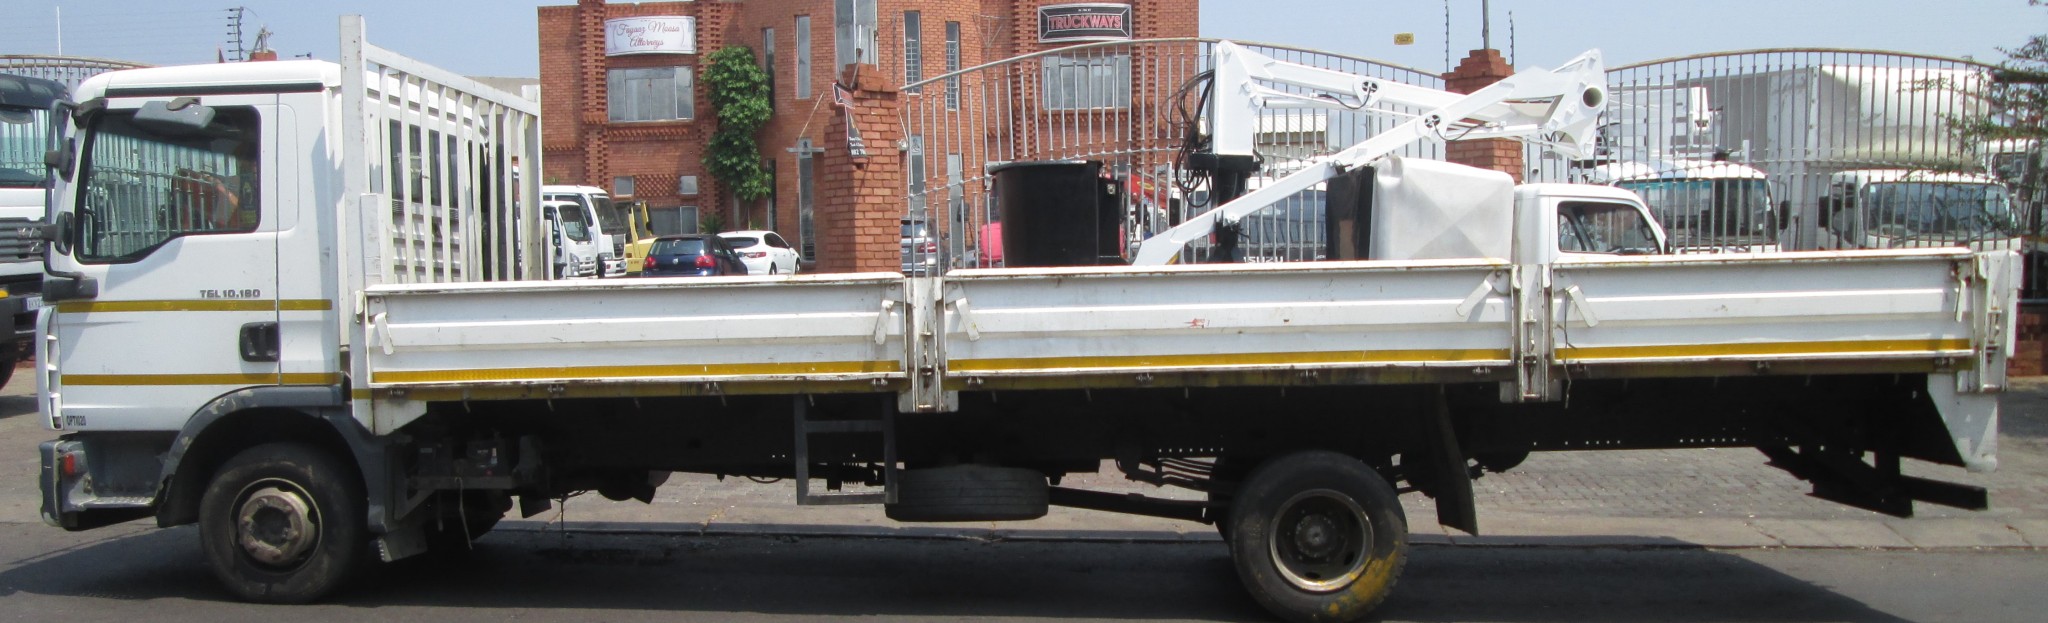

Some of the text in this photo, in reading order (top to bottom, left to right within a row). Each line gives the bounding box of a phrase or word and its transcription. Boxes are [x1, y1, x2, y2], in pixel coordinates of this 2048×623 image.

[648, 21, 680, 33] Moosa
[1049, 15, 1121, 30] TRUCKWAYS
[629, 36, 664, 49] Attorneys
[222, 289, 260, 298] 10.180
